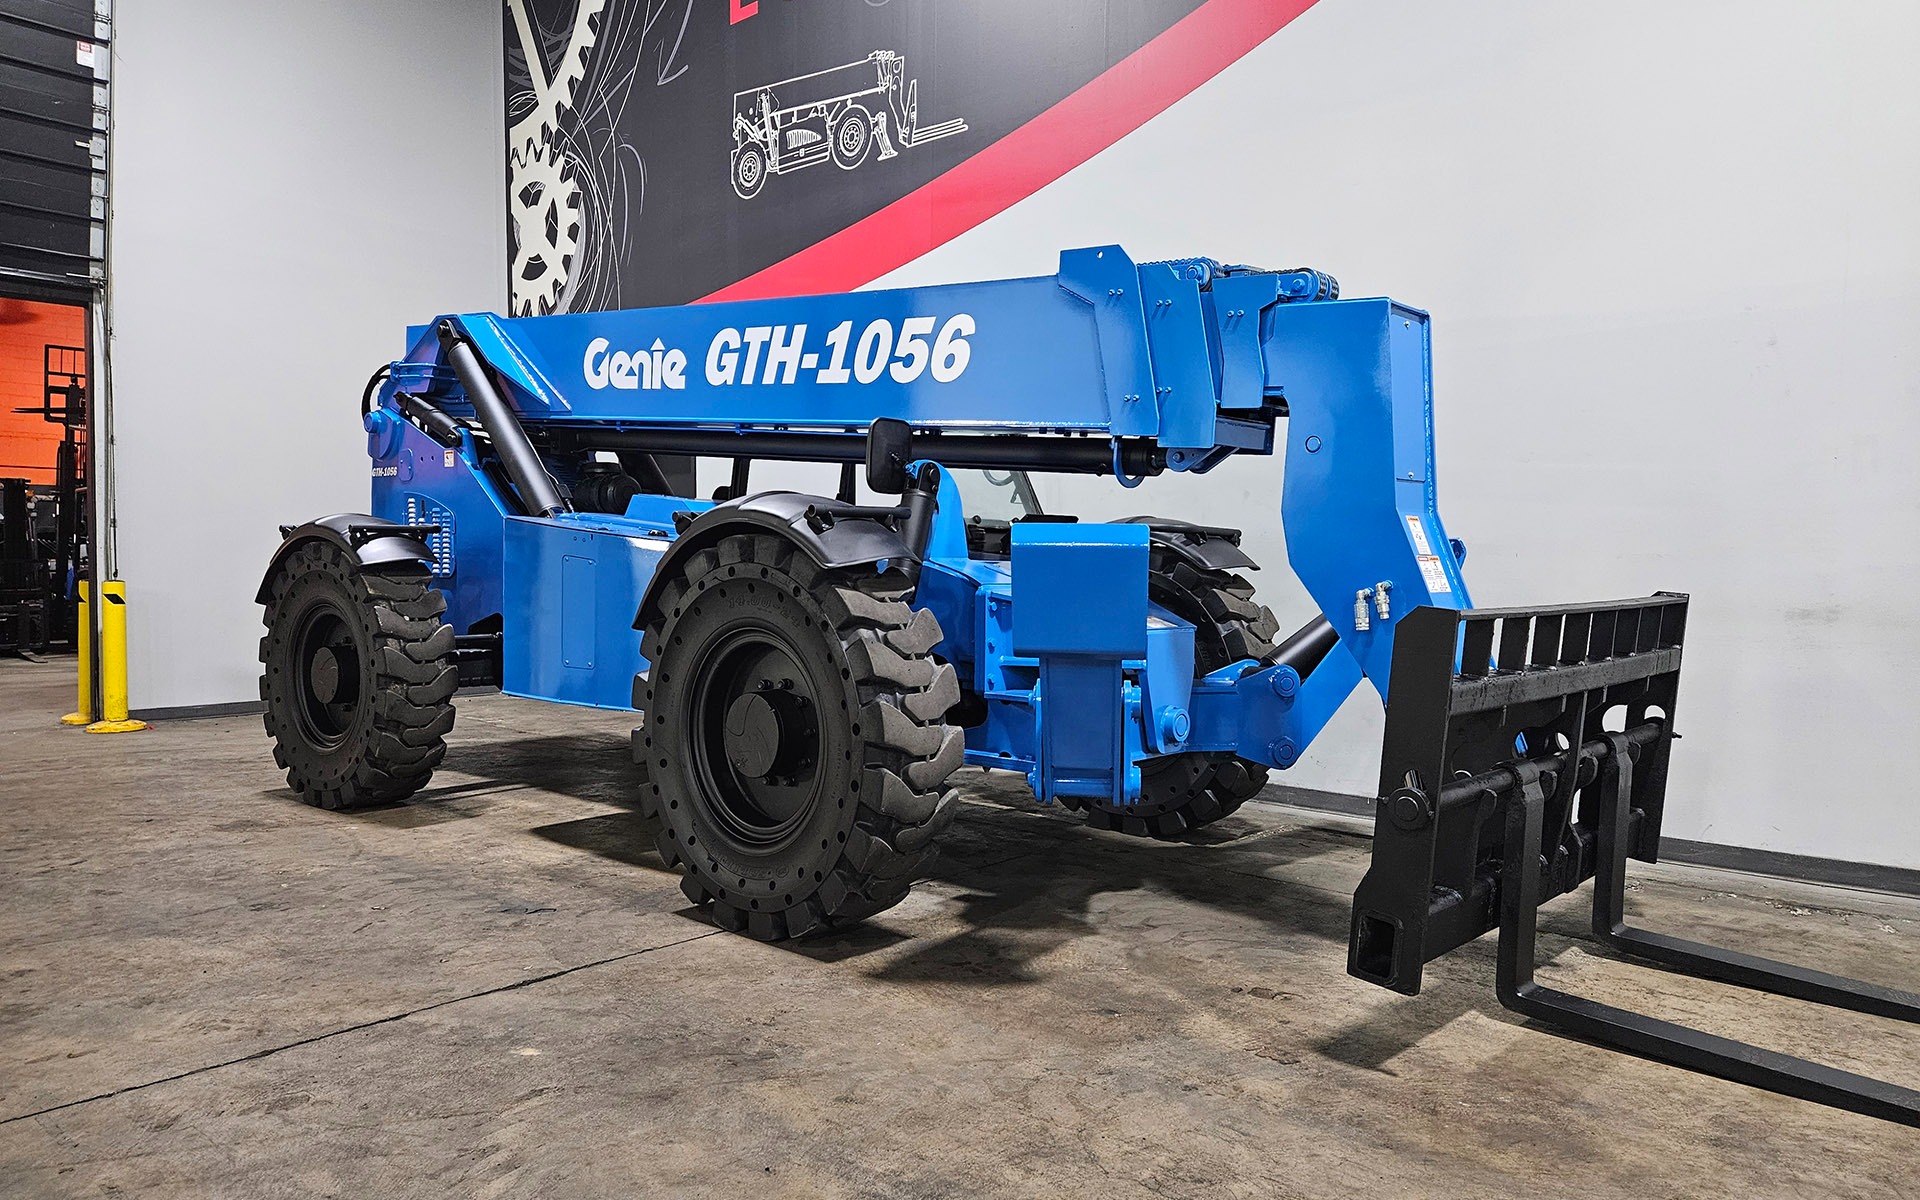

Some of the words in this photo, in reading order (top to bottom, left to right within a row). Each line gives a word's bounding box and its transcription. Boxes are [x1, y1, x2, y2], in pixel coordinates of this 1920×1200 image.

[583, 337, 687, 390] Genie
[705, 313, 976, 386] GTH-1056
[372, 466, 397, 476] GTH-1056
